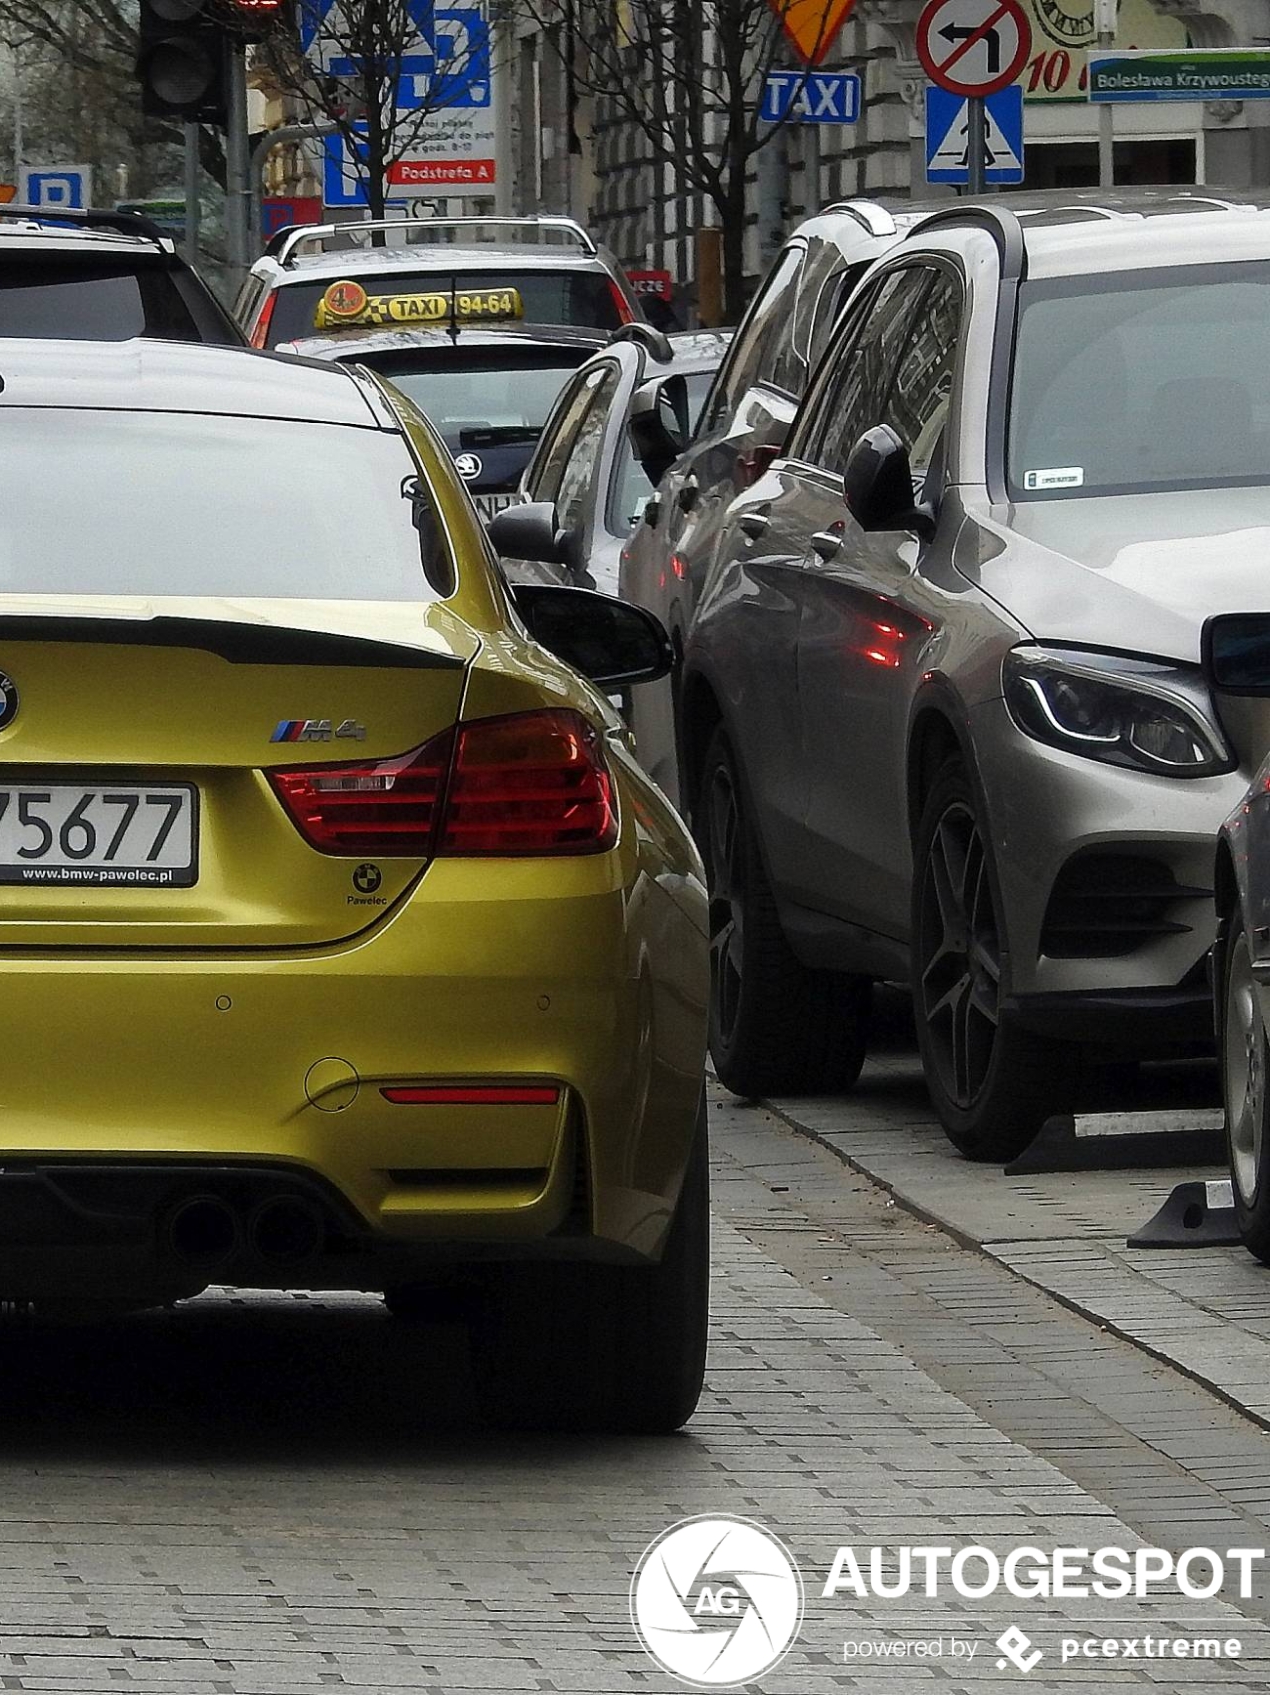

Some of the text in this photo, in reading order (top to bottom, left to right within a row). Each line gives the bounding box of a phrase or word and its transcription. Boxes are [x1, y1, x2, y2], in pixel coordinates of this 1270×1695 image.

[1097, 73, 1173, 88] Bolesława
[766, 77, 854, 117] TAXI
[400, 165, 489, 180] Podstrefa A
[397, 294, 512, 316] TAXI 94-64
[22, 866, 174, 883] www.bmw-pawelec.pl
[346, 895, 388, 906] Pawelec
